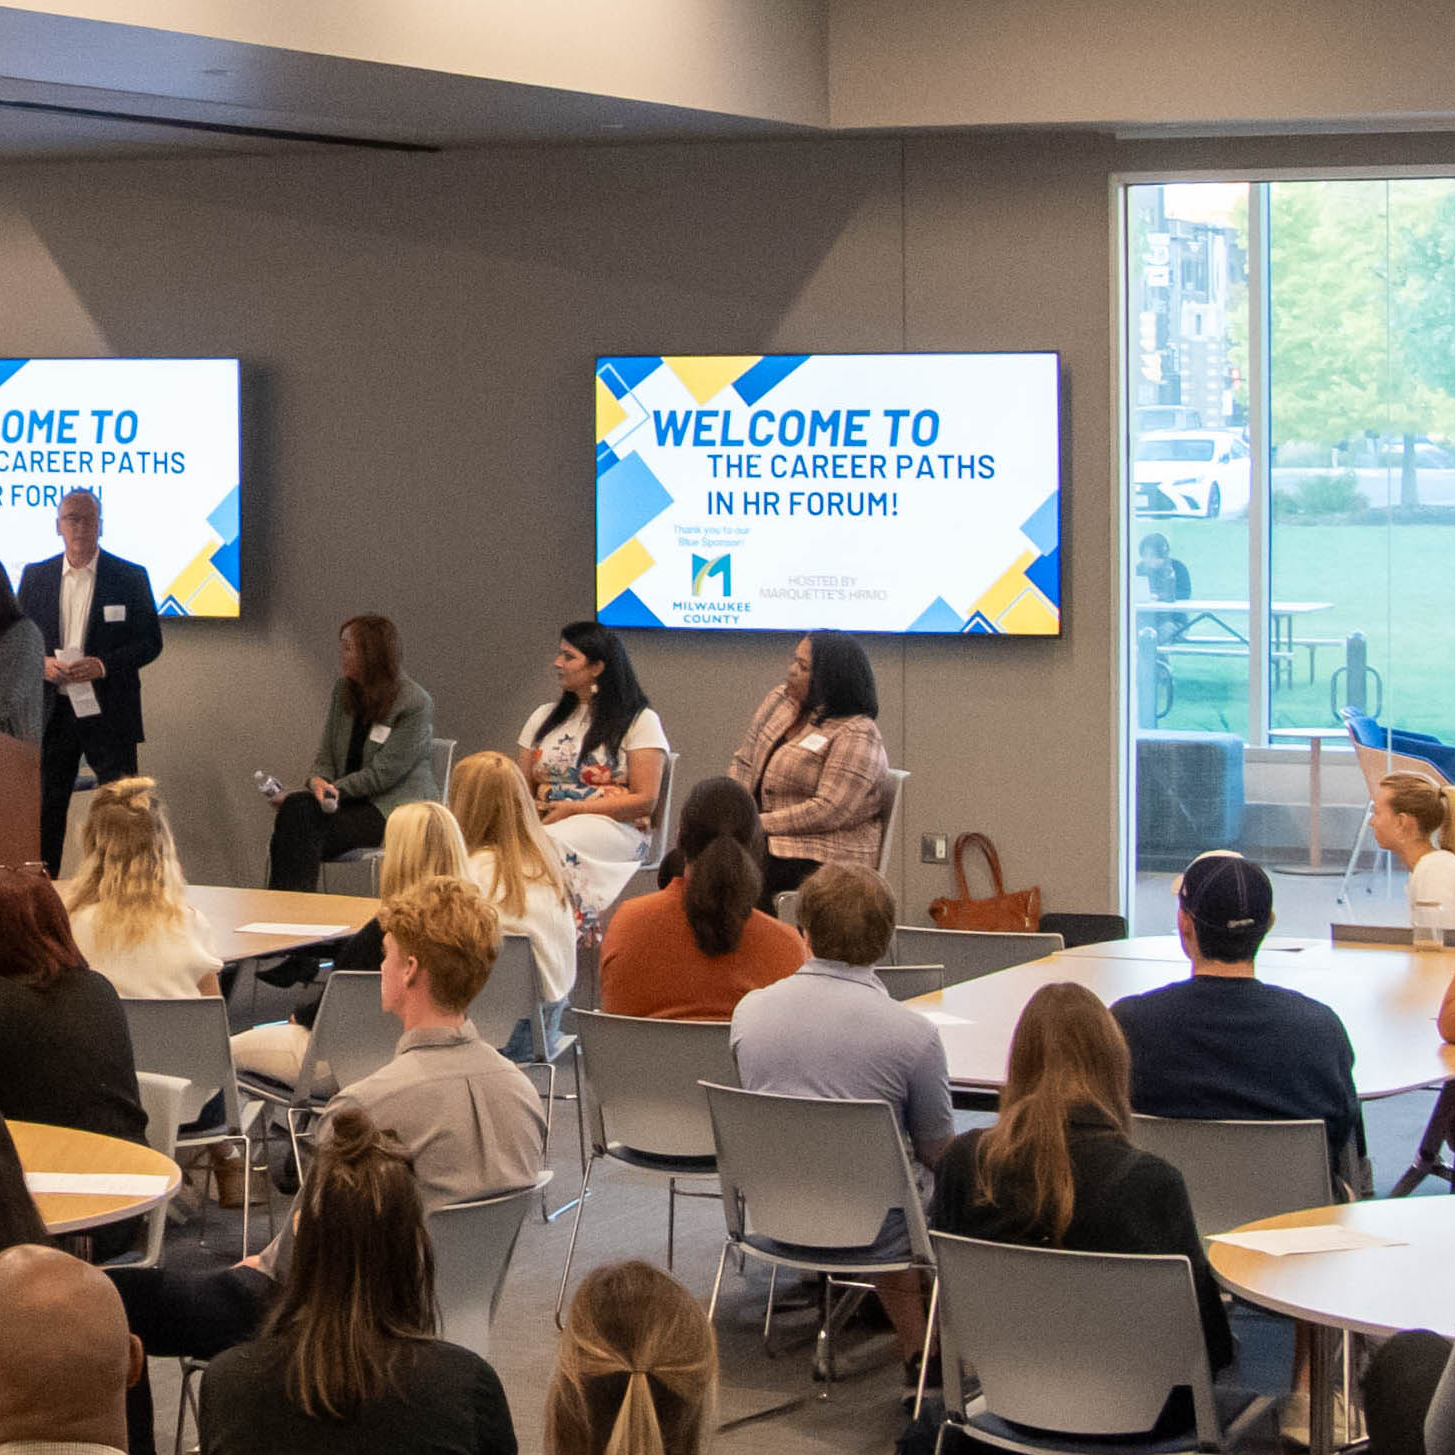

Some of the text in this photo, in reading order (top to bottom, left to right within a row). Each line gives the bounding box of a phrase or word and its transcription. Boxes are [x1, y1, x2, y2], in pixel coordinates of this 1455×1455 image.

[90, 409, 139, 444] TO
[652, 408, 941, 448] WELCOME TO
[101, 450, 186, 475] PATHS
[706, 453, 995, 480] THE CAREER PATHS
[707, 491, 898, 517] IN HR FORUM!
[787, 575, 858, 588] HOSTED BY
[673, 601, 752, 613] MILWAUKEE
[683, 613, 739, 624] COUNTY
